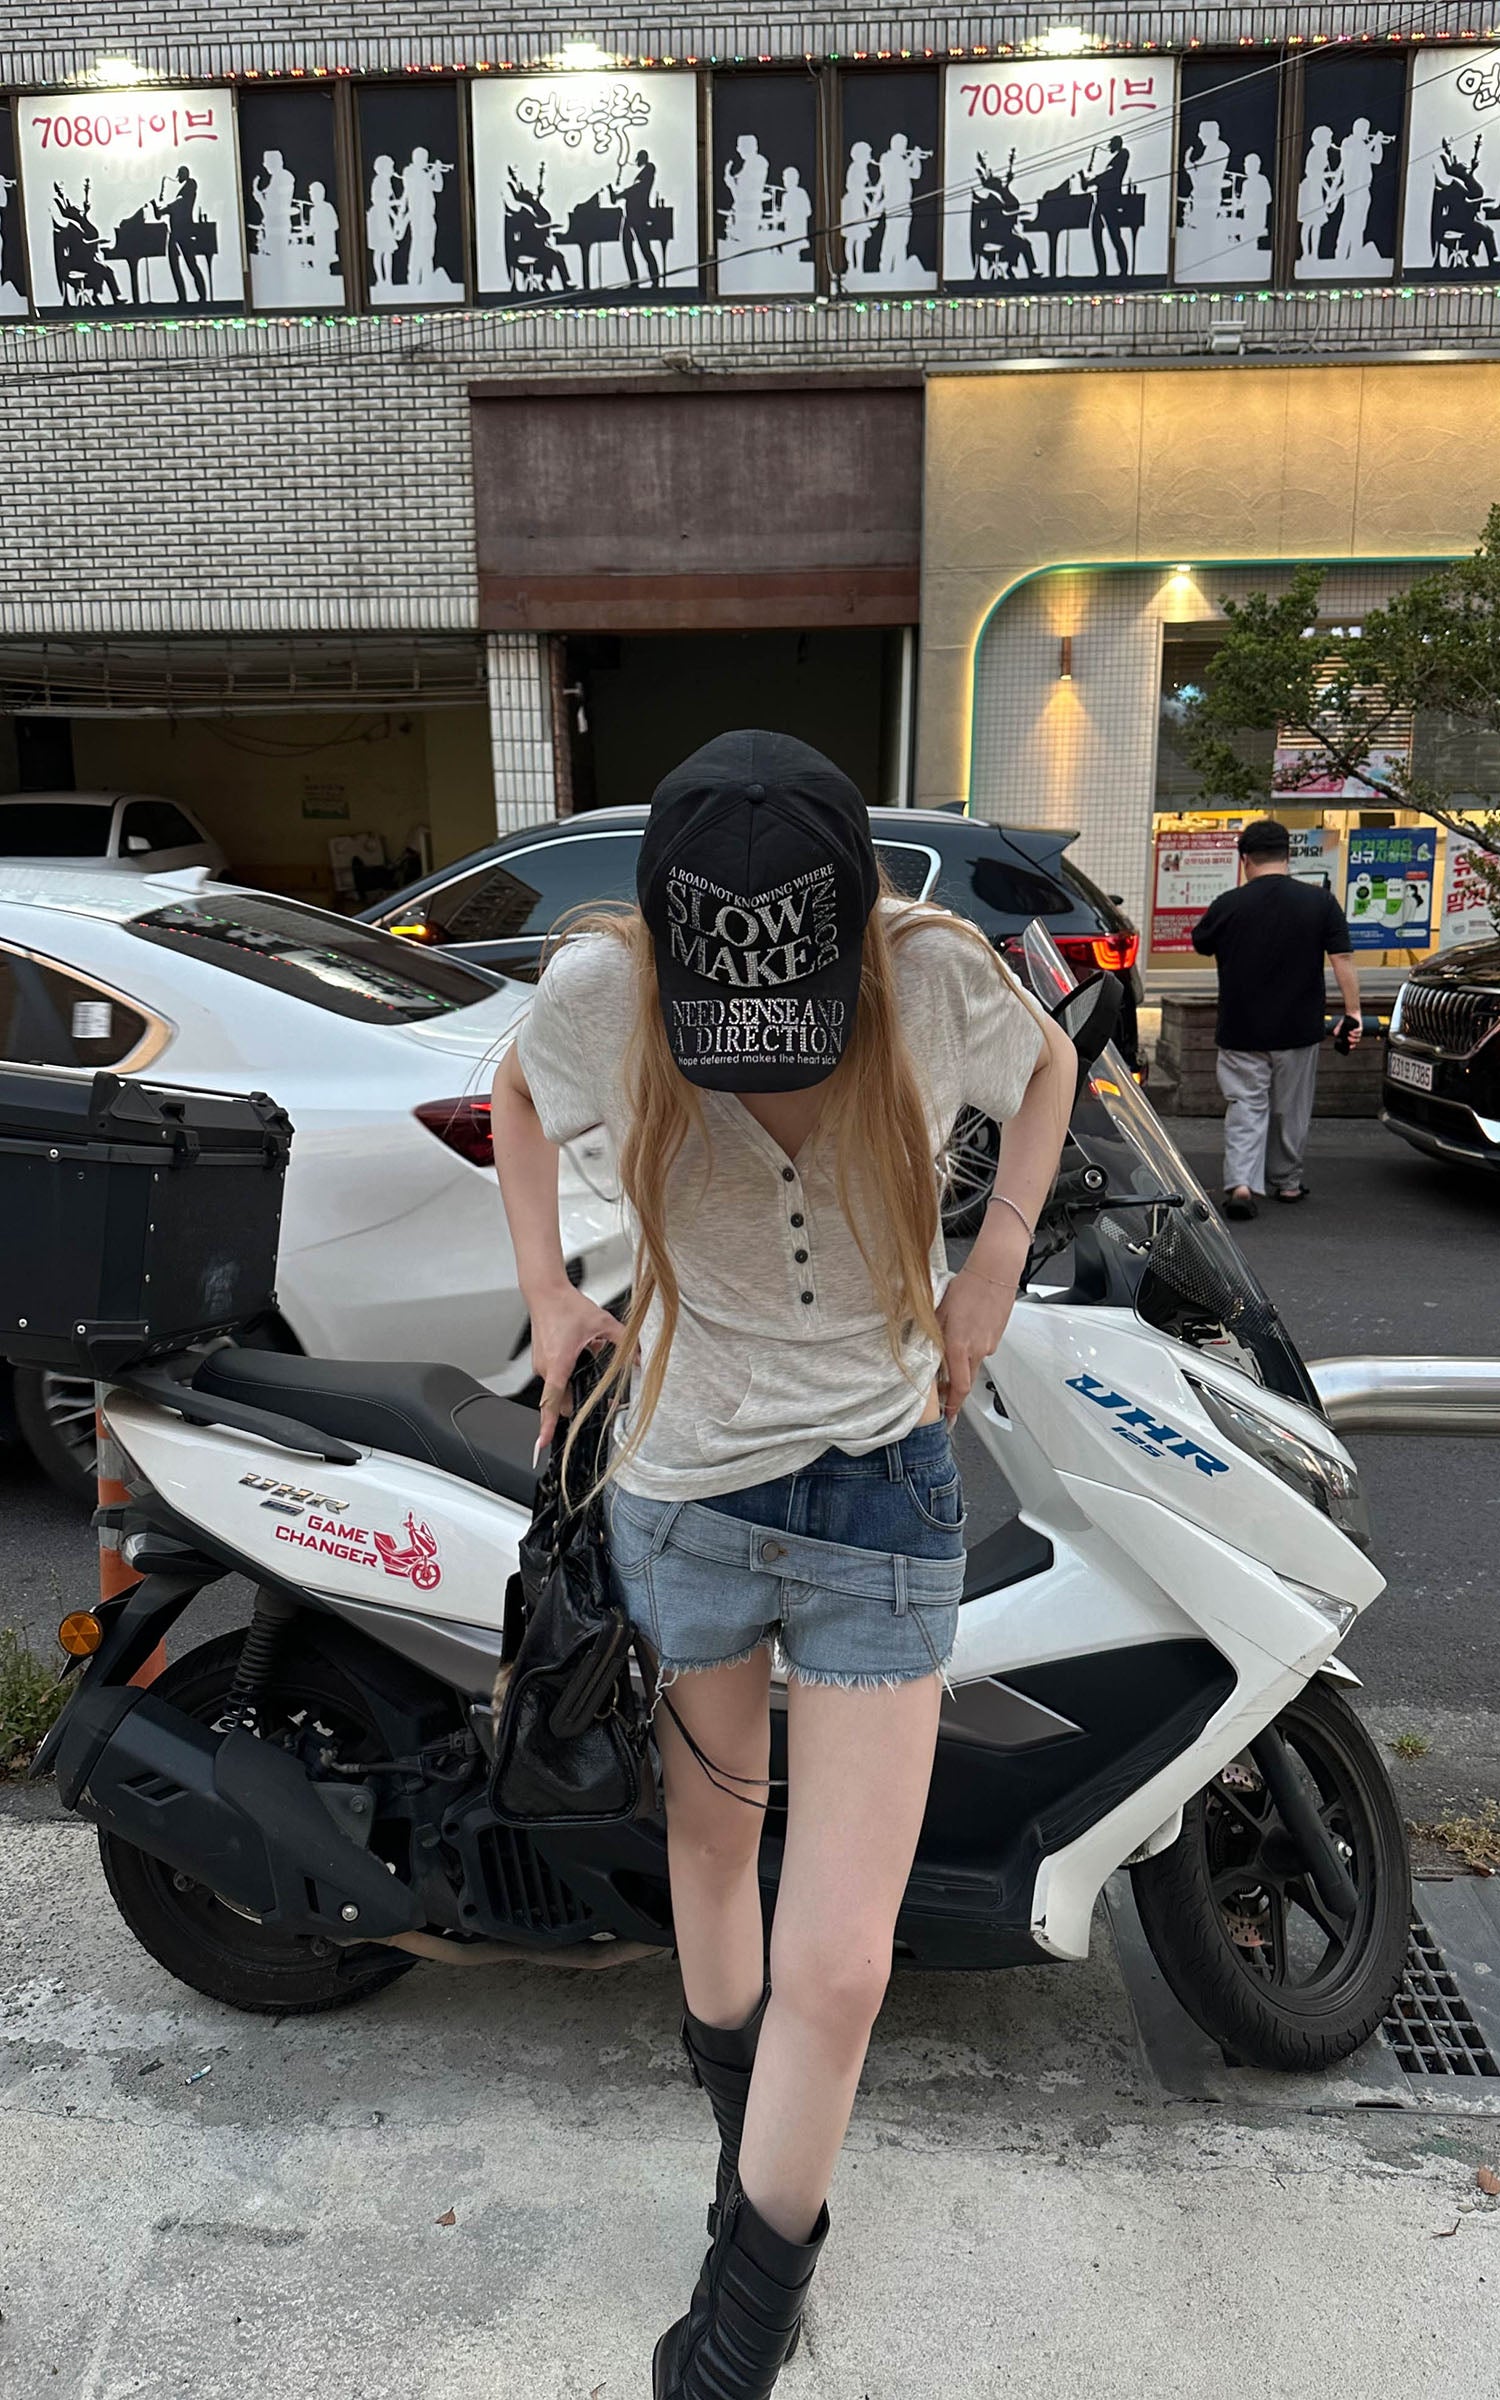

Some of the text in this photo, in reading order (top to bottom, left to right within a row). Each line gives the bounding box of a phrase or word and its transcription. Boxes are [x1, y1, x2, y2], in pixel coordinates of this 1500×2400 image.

[960, 76, 1157, 118] 7080라이브
[31, 107, 220, 150] 7080라이브
[669, 863, 835, 909] A ROAD NOT KNOWING WHERE
[667, 879, 812, 947] SLOW
[668, 920, 816, 987] MAKE
[672, 998, 846, 1027] NEED SENSE AND
[673, 1024, 843, 1054] A DIRECTION
[700, 1053, 740, 1065] deferred
[742, 1053, 777, 1063] makes
[779, 1053, 795, 1064] the
[797, 1054, 820, 1064] heart
[822, 1055, 837, 1065] sick
[1065, 1373, 1230, 1478] UHR
[1111, 1426, 1166, 1458] 125
[275, 1525, 378, 1568] CHANGER
[307, 1514, 370, 1545] GAME
